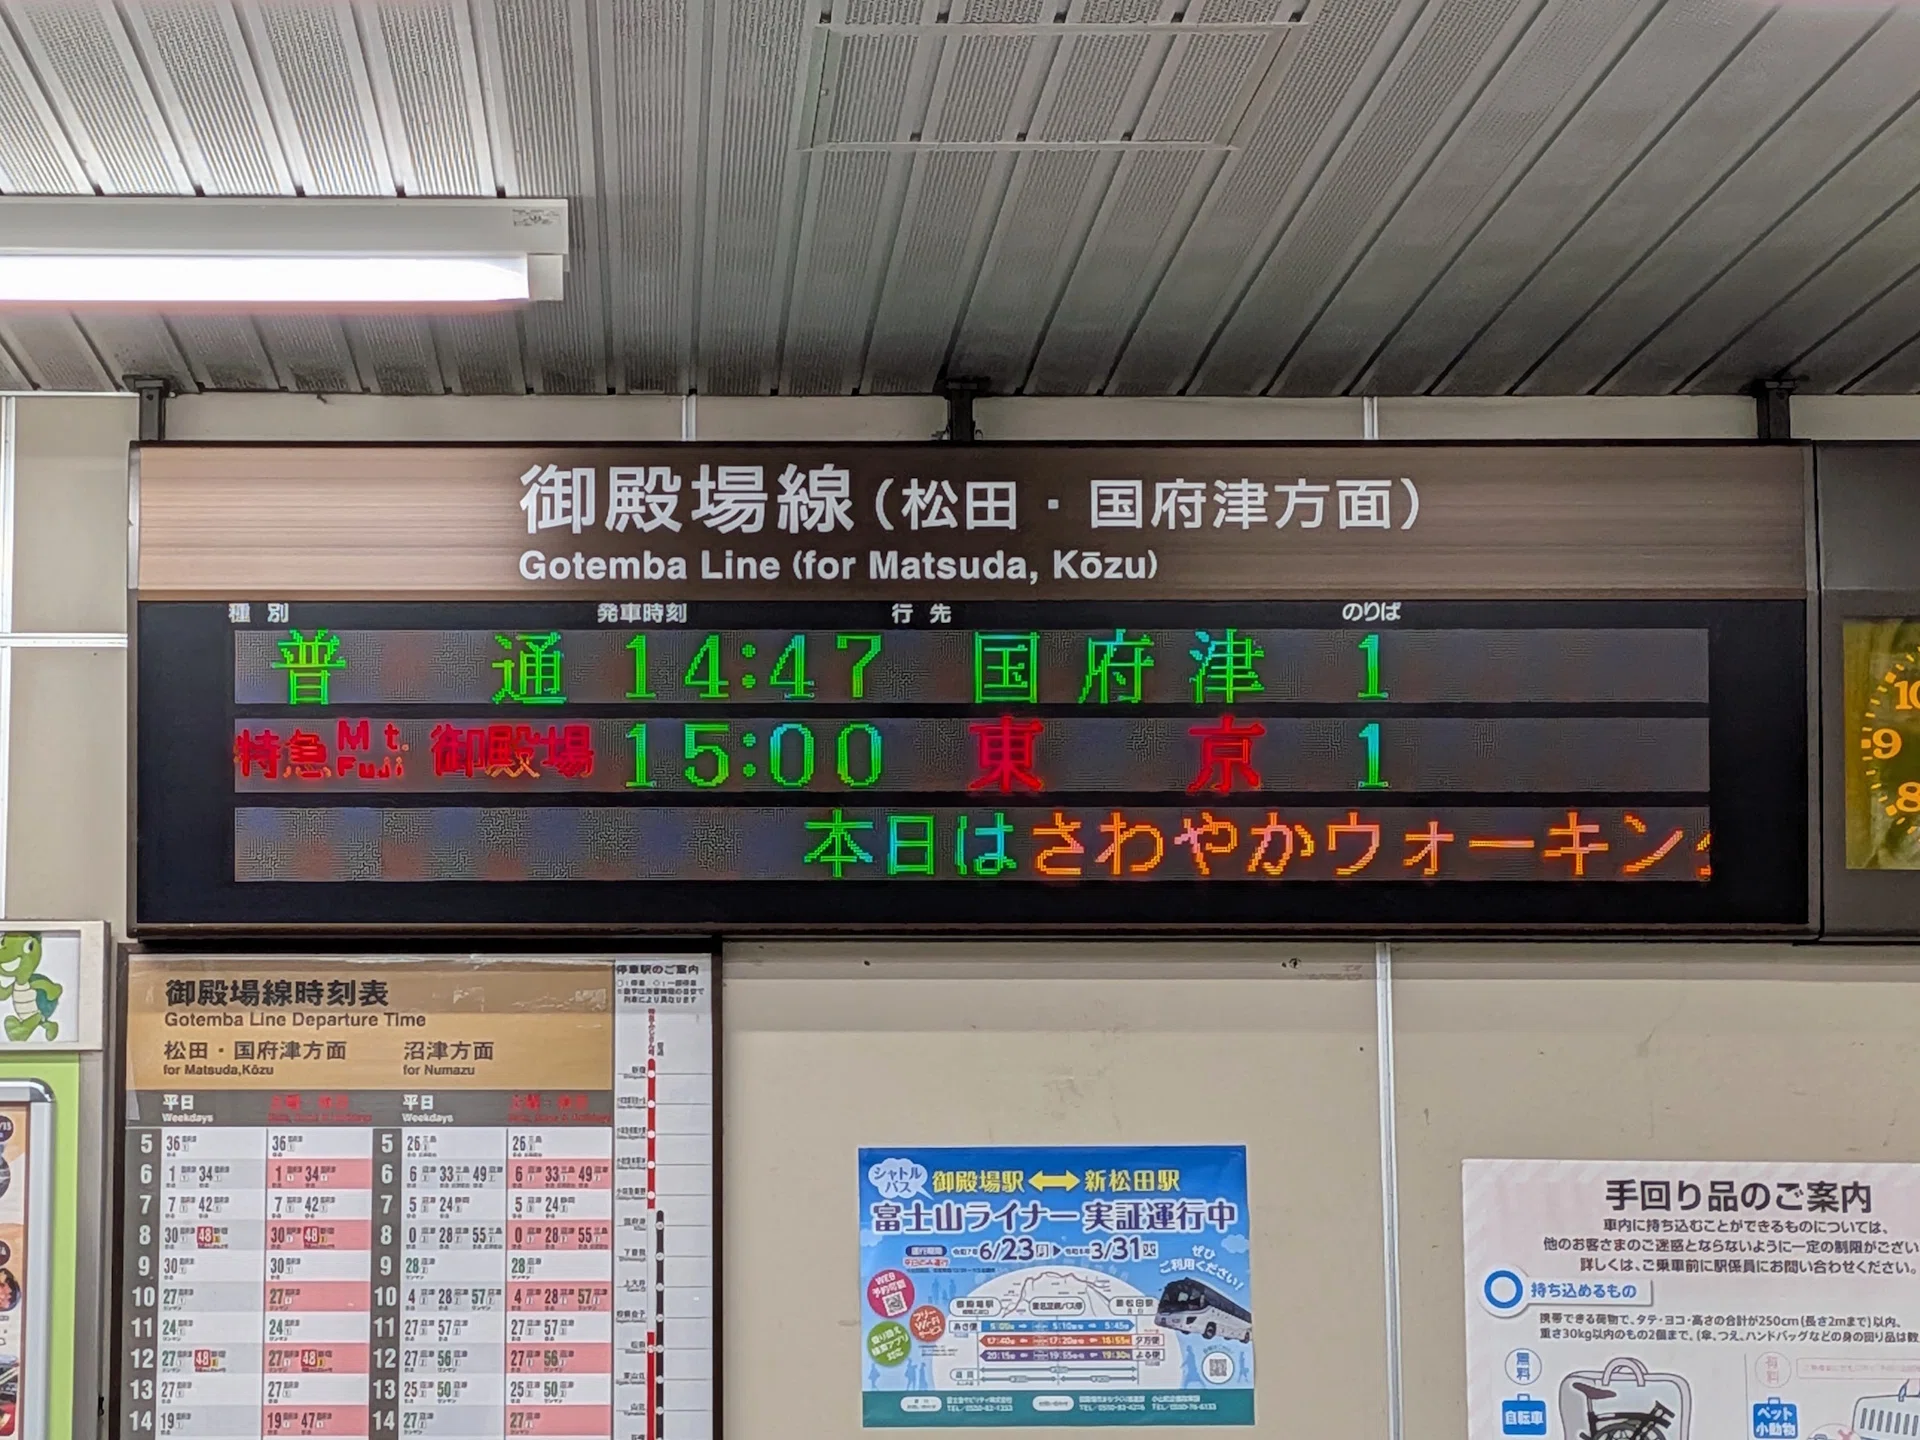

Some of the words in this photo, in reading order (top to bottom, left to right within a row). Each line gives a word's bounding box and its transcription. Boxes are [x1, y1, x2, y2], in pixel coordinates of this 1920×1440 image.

[520, 549, 687, 580] Gotemba
[702, 549, 780, 580] Line
[793, 549, 855, 581] (for
[869, 549, 1039, 585] Matsuda,
[1053, 549, 1158, 582] Kōzu)
[597, 602, 688, 624] 発車時刻
[1342, 601, 1401, 622] のりば
[625, 633, 883, 700] 14:47
[1357, 633, 1390, 700] 1
[1871, 728, 1902, 759] 9
[234, 728, 332, 779] 特急
[430, 723, 596, 779] 御殿場
[625, 723, 883, 788] 15:00
[1357, 722, 1390, 789] 1
[337, 755, 405, 779] Fuji
[1895, 781, 1920, 813] 8
[804, 808, 1711, 880] 本日はさわやかウォーキン
[166, 979, 389, 1007] 御殿場線時刻表
[165, 1012, 244, 1028] Gotemba
[250, 1012, 286, 1028] Line
[292, 1012, 379, 1031] Departure
[383, 1012, 426, 1028] Time
[164, 1040, 348, 1061] 松田・国府津方面
[403, 1040, 494, 1061] 沼津方面
[163, 1064, 181, 1076] for
[402, 1064, 422, 1076] for
[424, 1064, 476, 1076] Numazu
[163, 1094, 195, 1111] 平日
[402, 1094, 434, 1111] 平日
[161, 1113, 215, 1125] Weekdays
[401, 1112, 453, 1124] Weekdays
[140, 1134, 153, 1153] 5
[166, 1136, 180, 1152] 36
[272, 1136, 286, 1152] 36
[381, 1134, 394, 1153] 5
[140, 1164, 152, 1184] 6
[199, 1166, 213, 1182] 34
[381, 1164, 394, 1184] 6
[873, 1167, 922, 1180] シャトル
[932, 1170, 1026, 1194] 御殿場駅
[1084, 1169, 1180, 1193] 新松田駅
[885, 1181, 912, 1193] バス
[1605, 1179, 1871, 1214] 手回り品のご案内
[140, 1195, 152, 1214] 7
[168, 1196, 177, 1212] 7
[198, 1196, 213, 1212] 42
[274, 1196, 283, 1212] 7
[305, 1196, 319, 1212] 42
[381, 1196, 394, 1214] 7
[140, 1226, 152, 1245] 8
[165, 1227, 178, 1243] 30
[198, 1227, 213, 1243] 48
[271, 1227, 285, 1243] 30
[305, 1227, 319, 1243] 48
[380, 1226, 393, 1245] 8
[1192, 1244, 1216, 1260] ぜひ
[138, 1257, 150, 1276] 9
[164, 1258, 178, 1274] 30
[270, 1258, 285, 1274] 30
[380, 1256, 393, 1276] 9
[132, 1287, 156, 1307] 10
[163, 1288, 178, 1304] 27
[270, 1288, 284, 1304] 27
[374, 1287, 398, 1307] 10
[1531, 1282, 1637, 1299] 持ち込めるもの
[131, 1317, 154, 1338] 11
[162, 1320, 177, 1336] 24
[270, 1320, 284, 1336] 24
[374, 1317, 396, 1338] 11
[130, 1349, 154, 1369] 12
[162, 1350, 176, 1366] 27
[196, 1350, 210, 1366] 48
[373, 1348, 396, 1368] 12
[1516, 1352, 1531, 1381] 無料
[130, 1379, 154, 1400] 13
[162, 1382, 176, 1398] 27
[268, 1382, 282, 1398] 27
[372, 1378, 396, 1400] 13
[130, 1409, 154, 1430] 14
[161, 1412, 175, 1428] 19
[373, 1409, 396, 1430] 14
[1504, 1410, 1544, 1426] 自転車
[1757, 1407, 1793, 1419] ペット
[1756, 1422, 1797, 1437] 小動物
